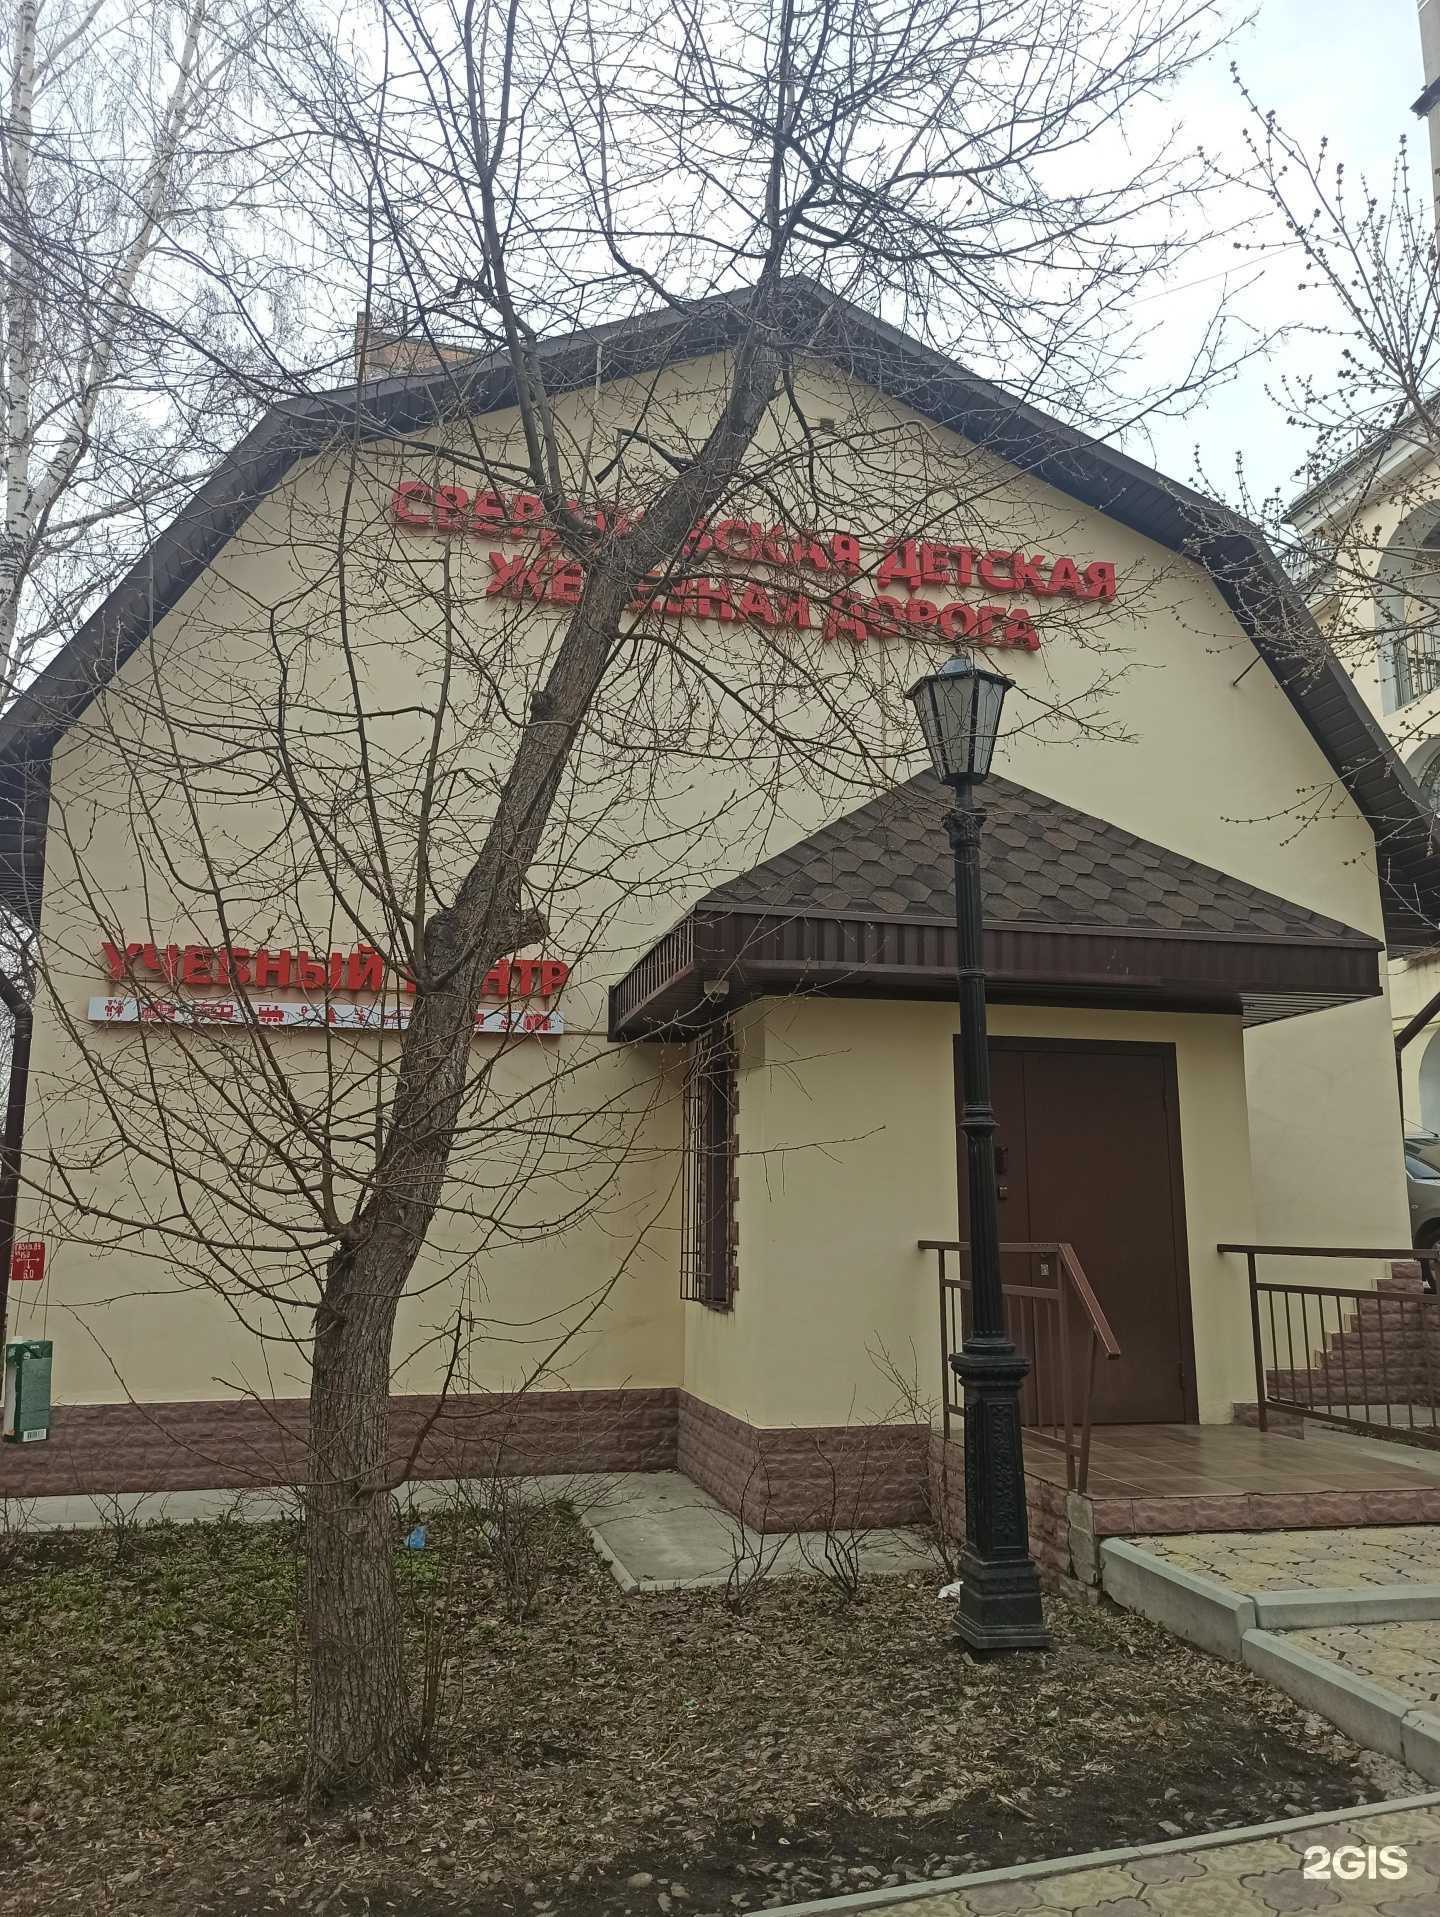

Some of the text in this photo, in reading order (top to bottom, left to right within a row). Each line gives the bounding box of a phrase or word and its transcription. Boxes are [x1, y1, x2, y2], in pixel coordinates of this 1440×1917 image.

[877, 537, 1116, 603] ДЕТСКАЯ
[821, 593, 1040, 652] ДОРОГА
[101, 942, 569, 998] УЧЕБНЫЙ НТР
